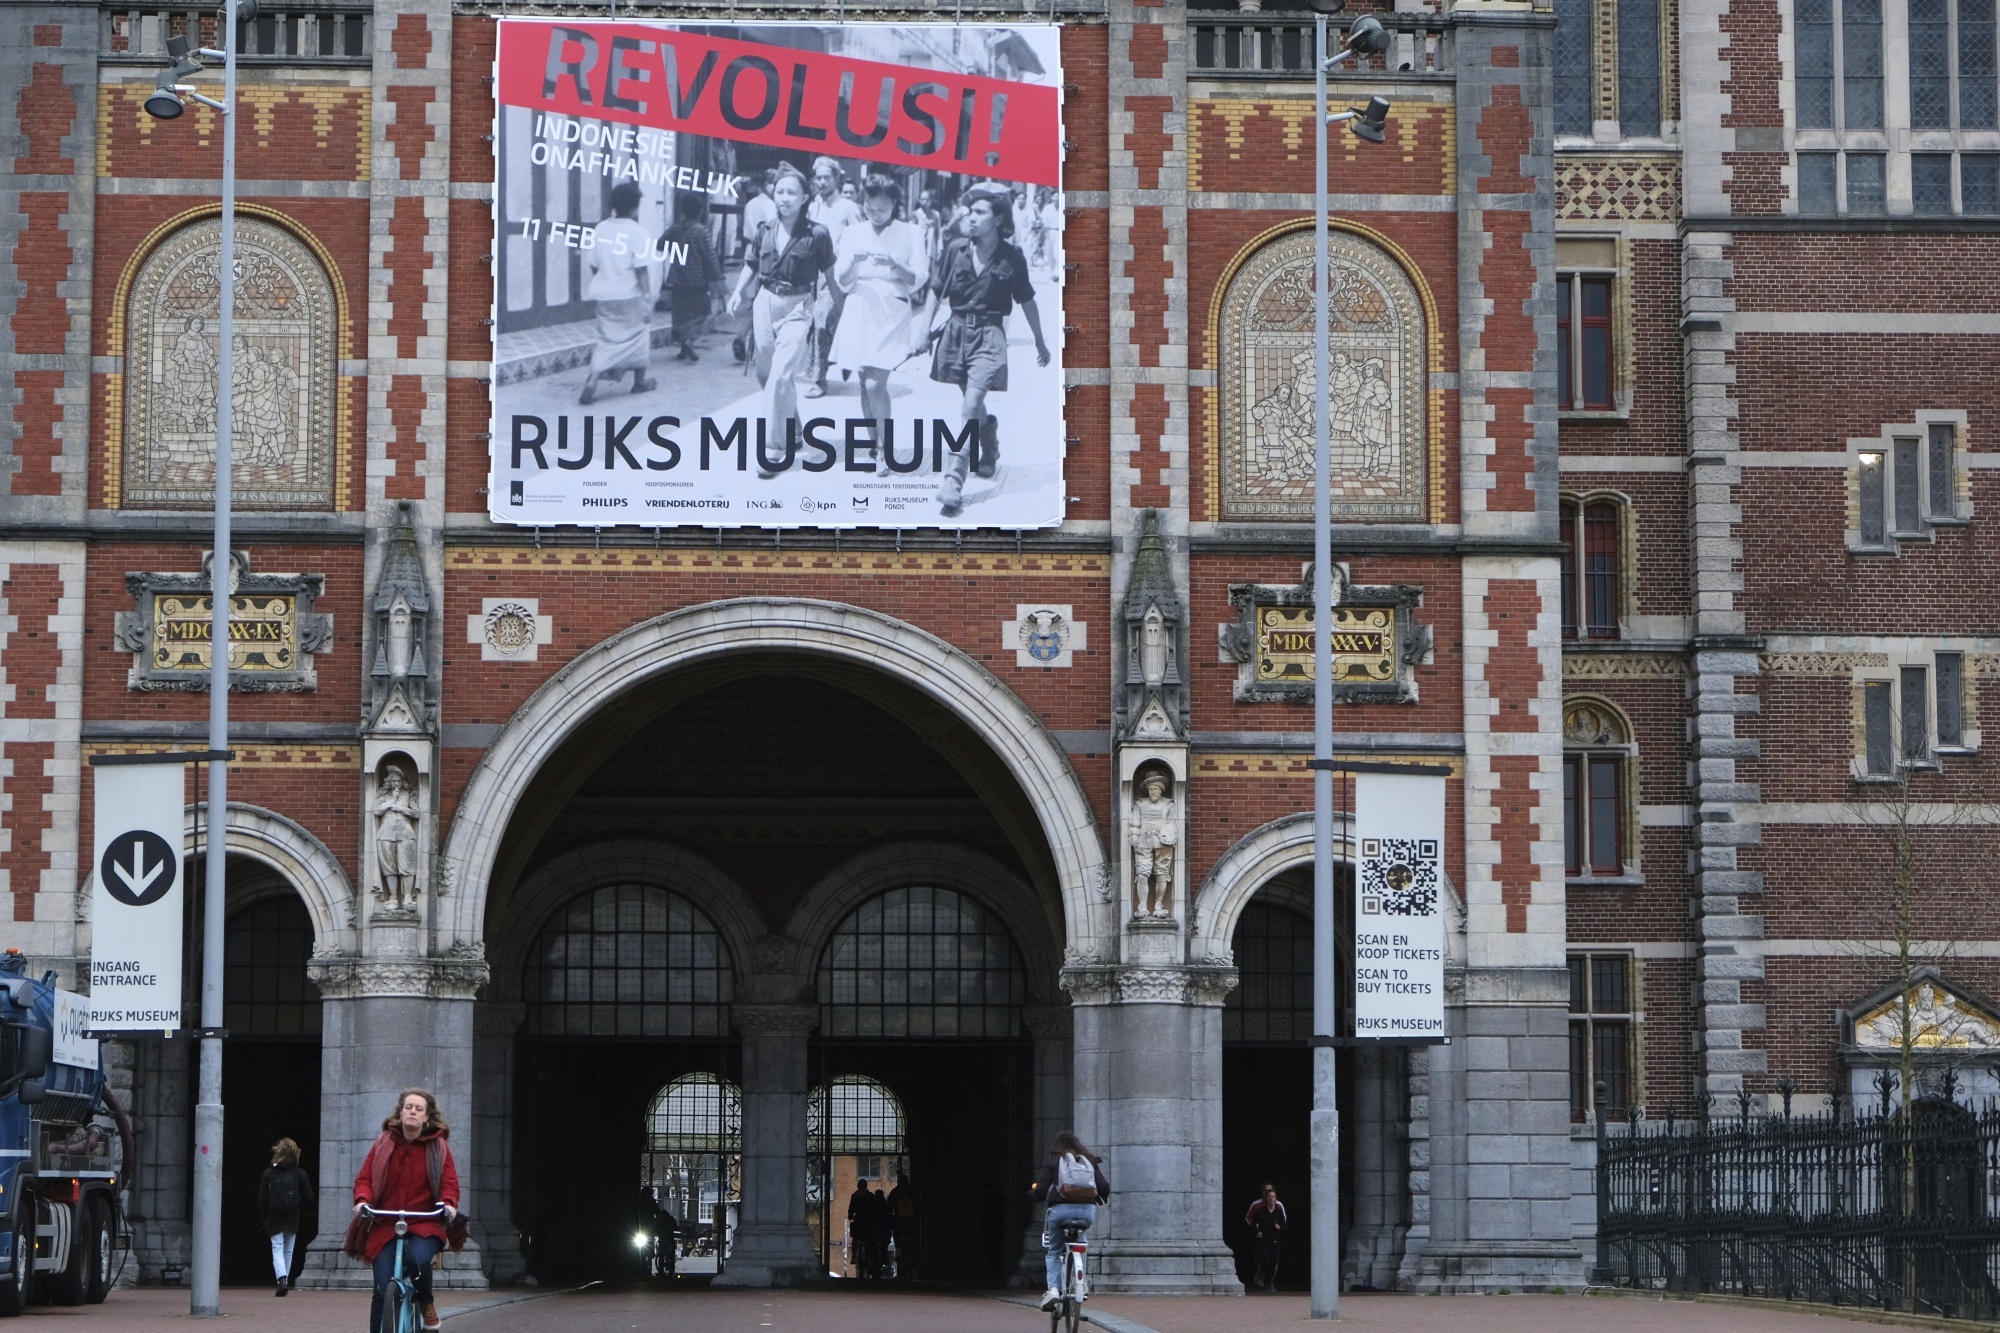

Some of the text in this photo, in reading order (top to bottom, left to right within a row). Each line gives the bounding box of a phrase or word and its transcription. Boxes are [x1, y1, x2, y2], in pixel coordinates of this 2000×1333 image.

[542, 26, 1009, 166] REVOLUSI!
[535, 115, 675, 160] INDONESIË
[531, 142, 743, 198] ONAFHANKELIJK
[520, 217, 541, 241] 11
[635, 237, 689, 266] JUN
[510, 414, 980, 473] RIJKS MUSEUM
[582, 497, 628, 507] PHILIPS
[644, 499, 730, 509] VRIENDENLOTERIJ
[746, 500, 768, 509] ING
[817, 501, 837, 511] kpn
[1357, 934, 1408, 946] SCAN EN
[1357, 948, 1440, 960] KOOP TICKETS
[93, 961, 140, 972] INGANG
[1357, 968, 1408, 980] SCAN TO
[92, 975, 157, 986] ENTRANCE
[1357, 982, 1432, 994] BUY TICKETS
[91, 1010, 179, 1022] RIJKS MUSEUM
[1357, 1018, 1443, 1030] RIJKS MUSEUM
